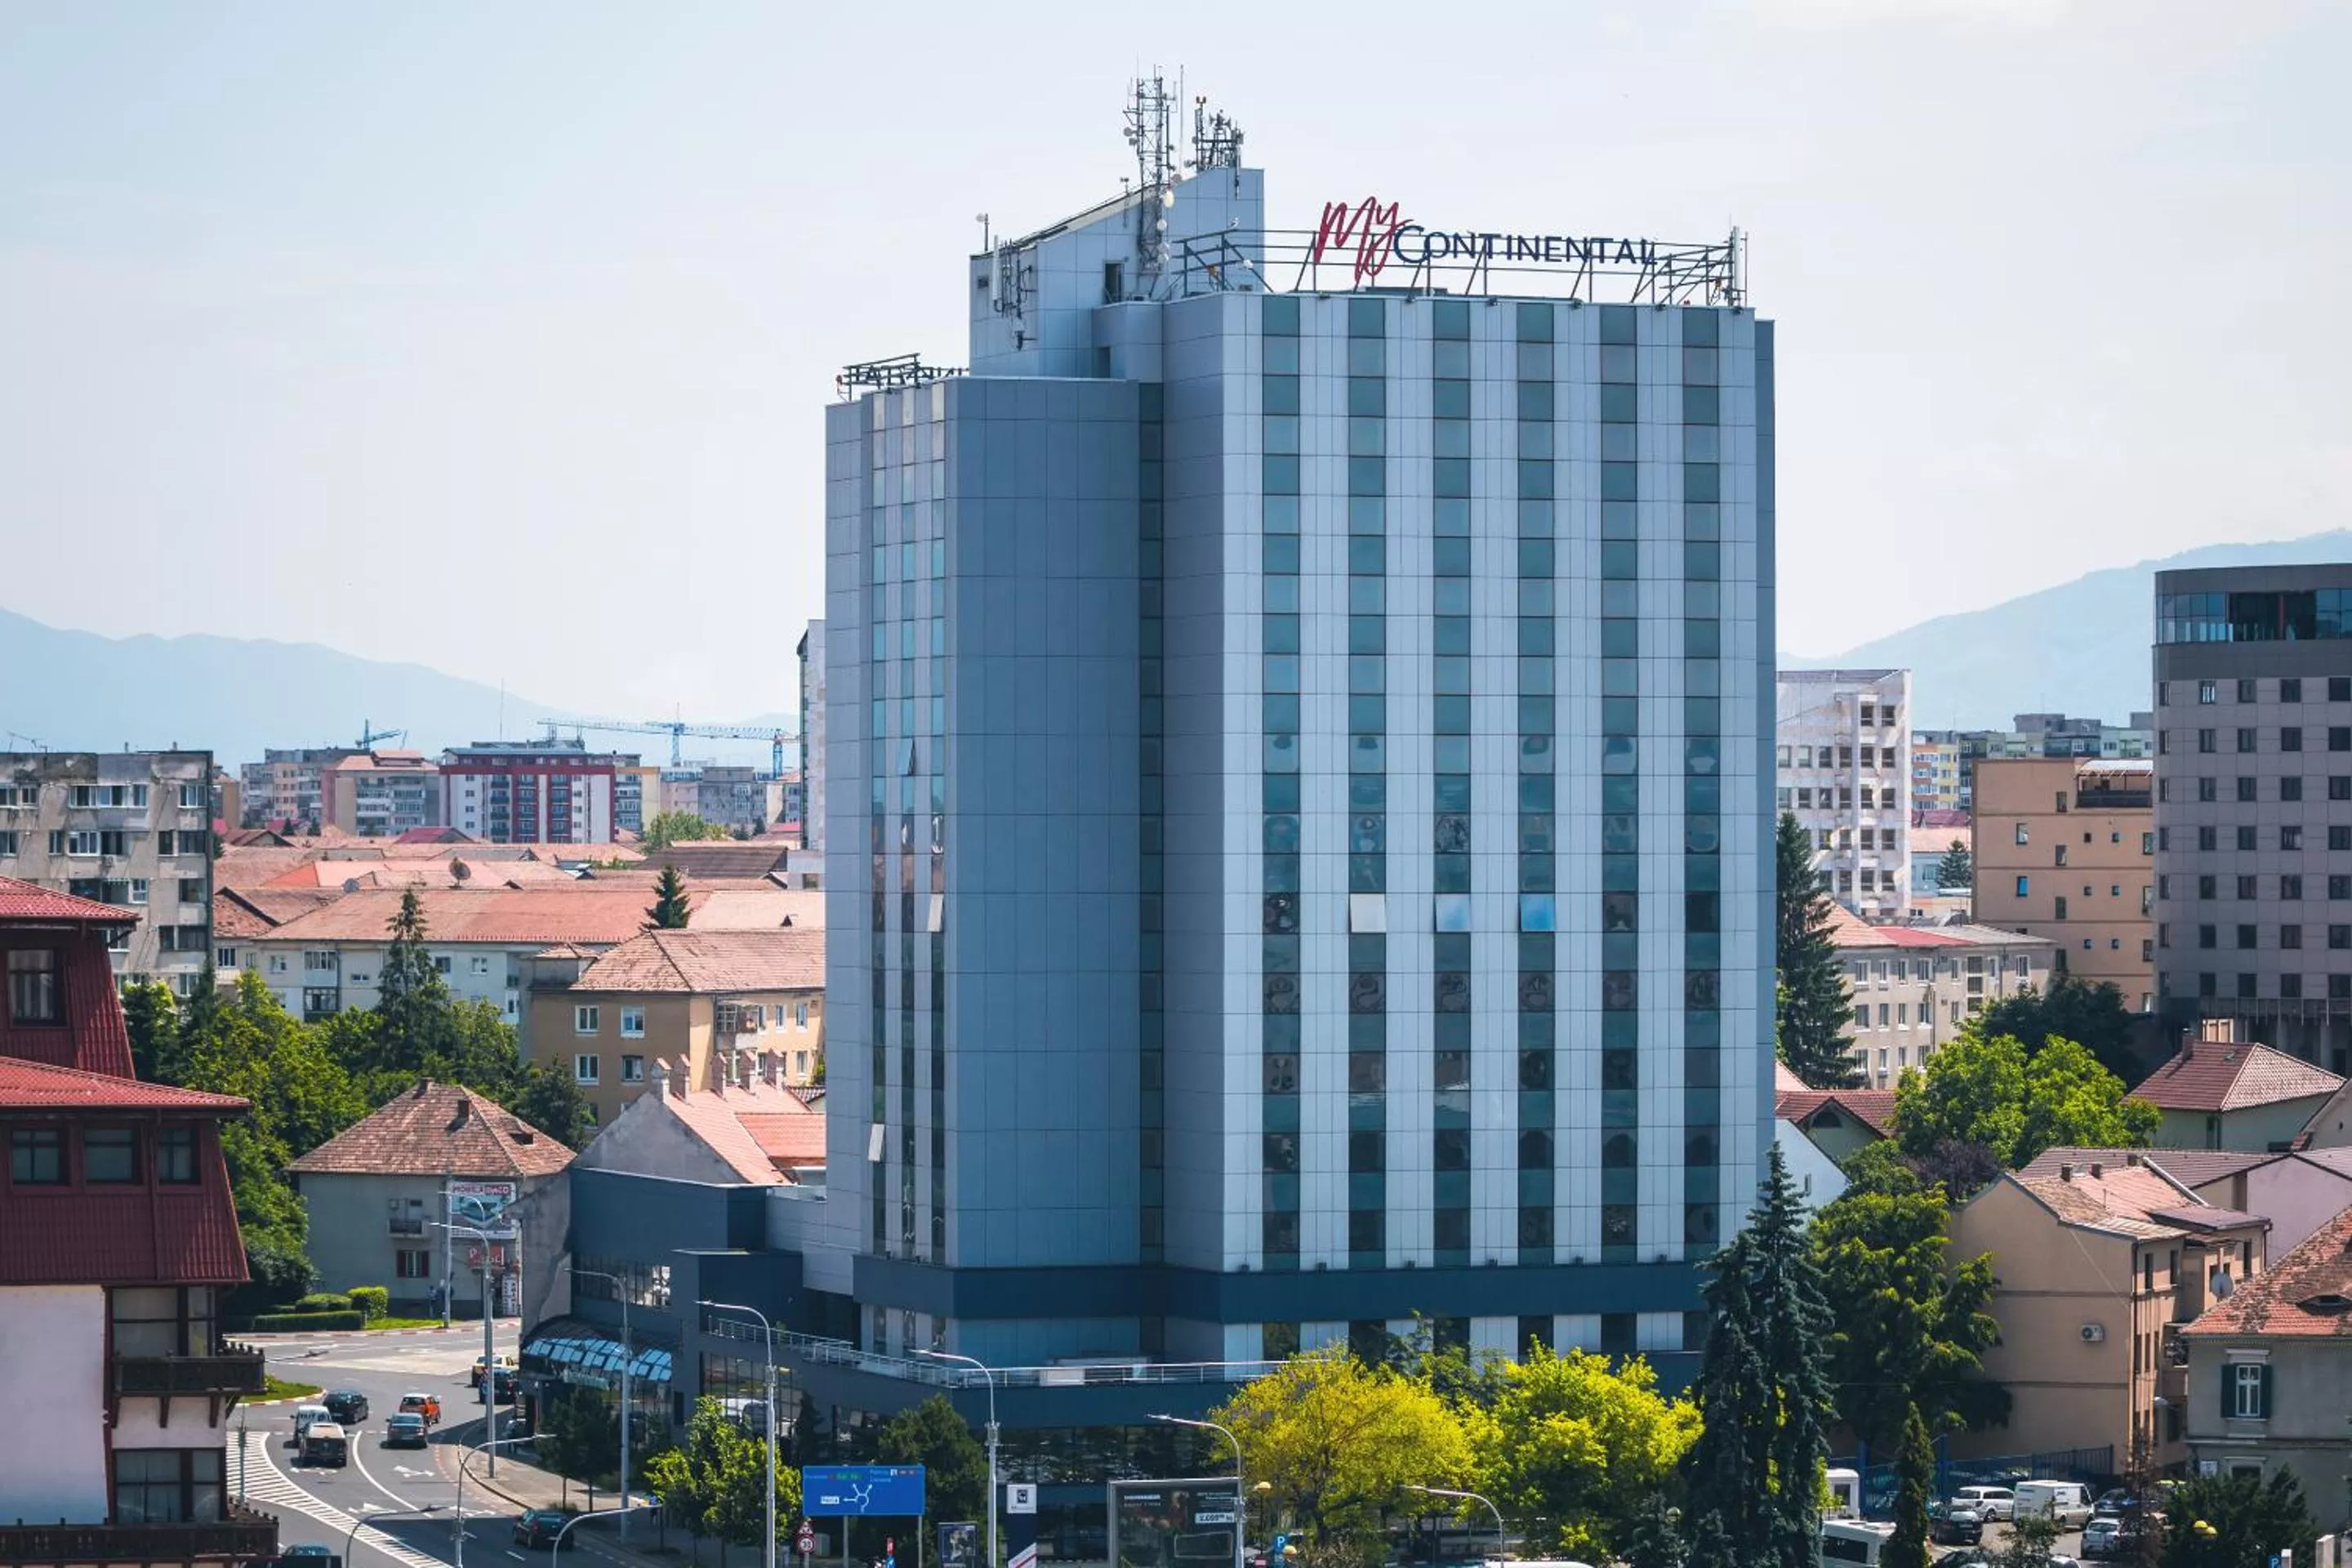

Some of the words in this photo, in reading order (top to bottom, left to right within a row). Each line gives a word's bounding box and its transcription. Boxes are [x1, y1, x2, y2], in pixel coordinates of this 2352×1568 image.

[1393, 225, 1658, 265] CONTINENTAL
[1277, 1535, 1285, 1548] P
[2271, 1557, 2279, 1568] P
